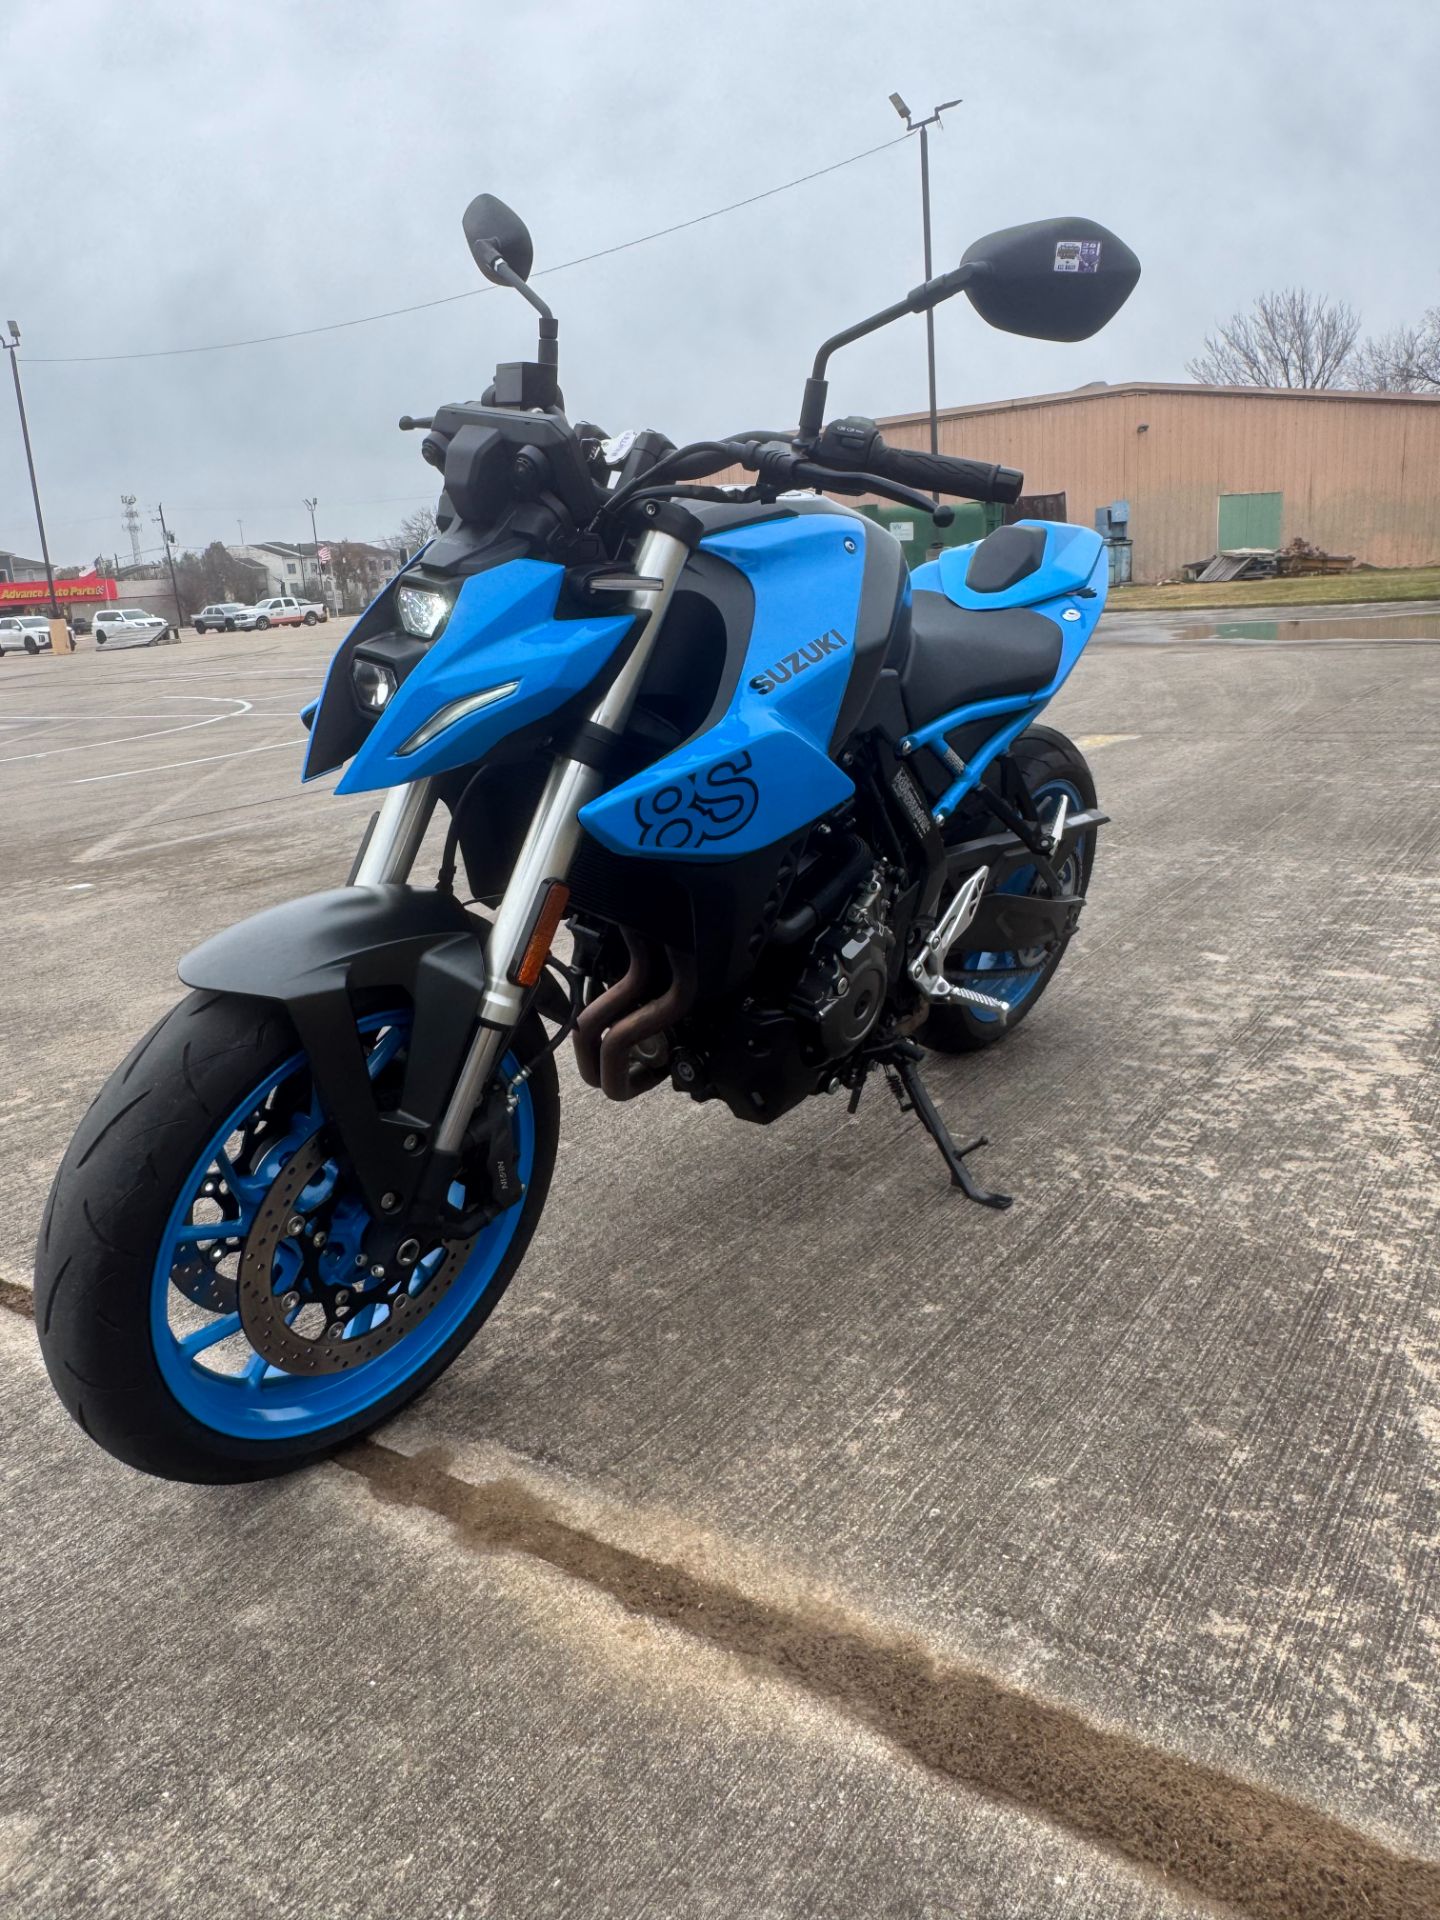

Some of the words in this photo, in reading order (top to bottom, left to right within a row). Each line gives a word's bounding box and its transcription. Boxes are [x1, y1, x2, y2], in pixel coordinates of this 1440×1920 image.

[2, 589, 43, 599] Advance
[70, 586, 96, 596] Parts
[749, 628, 848, 695] SUZUKI
